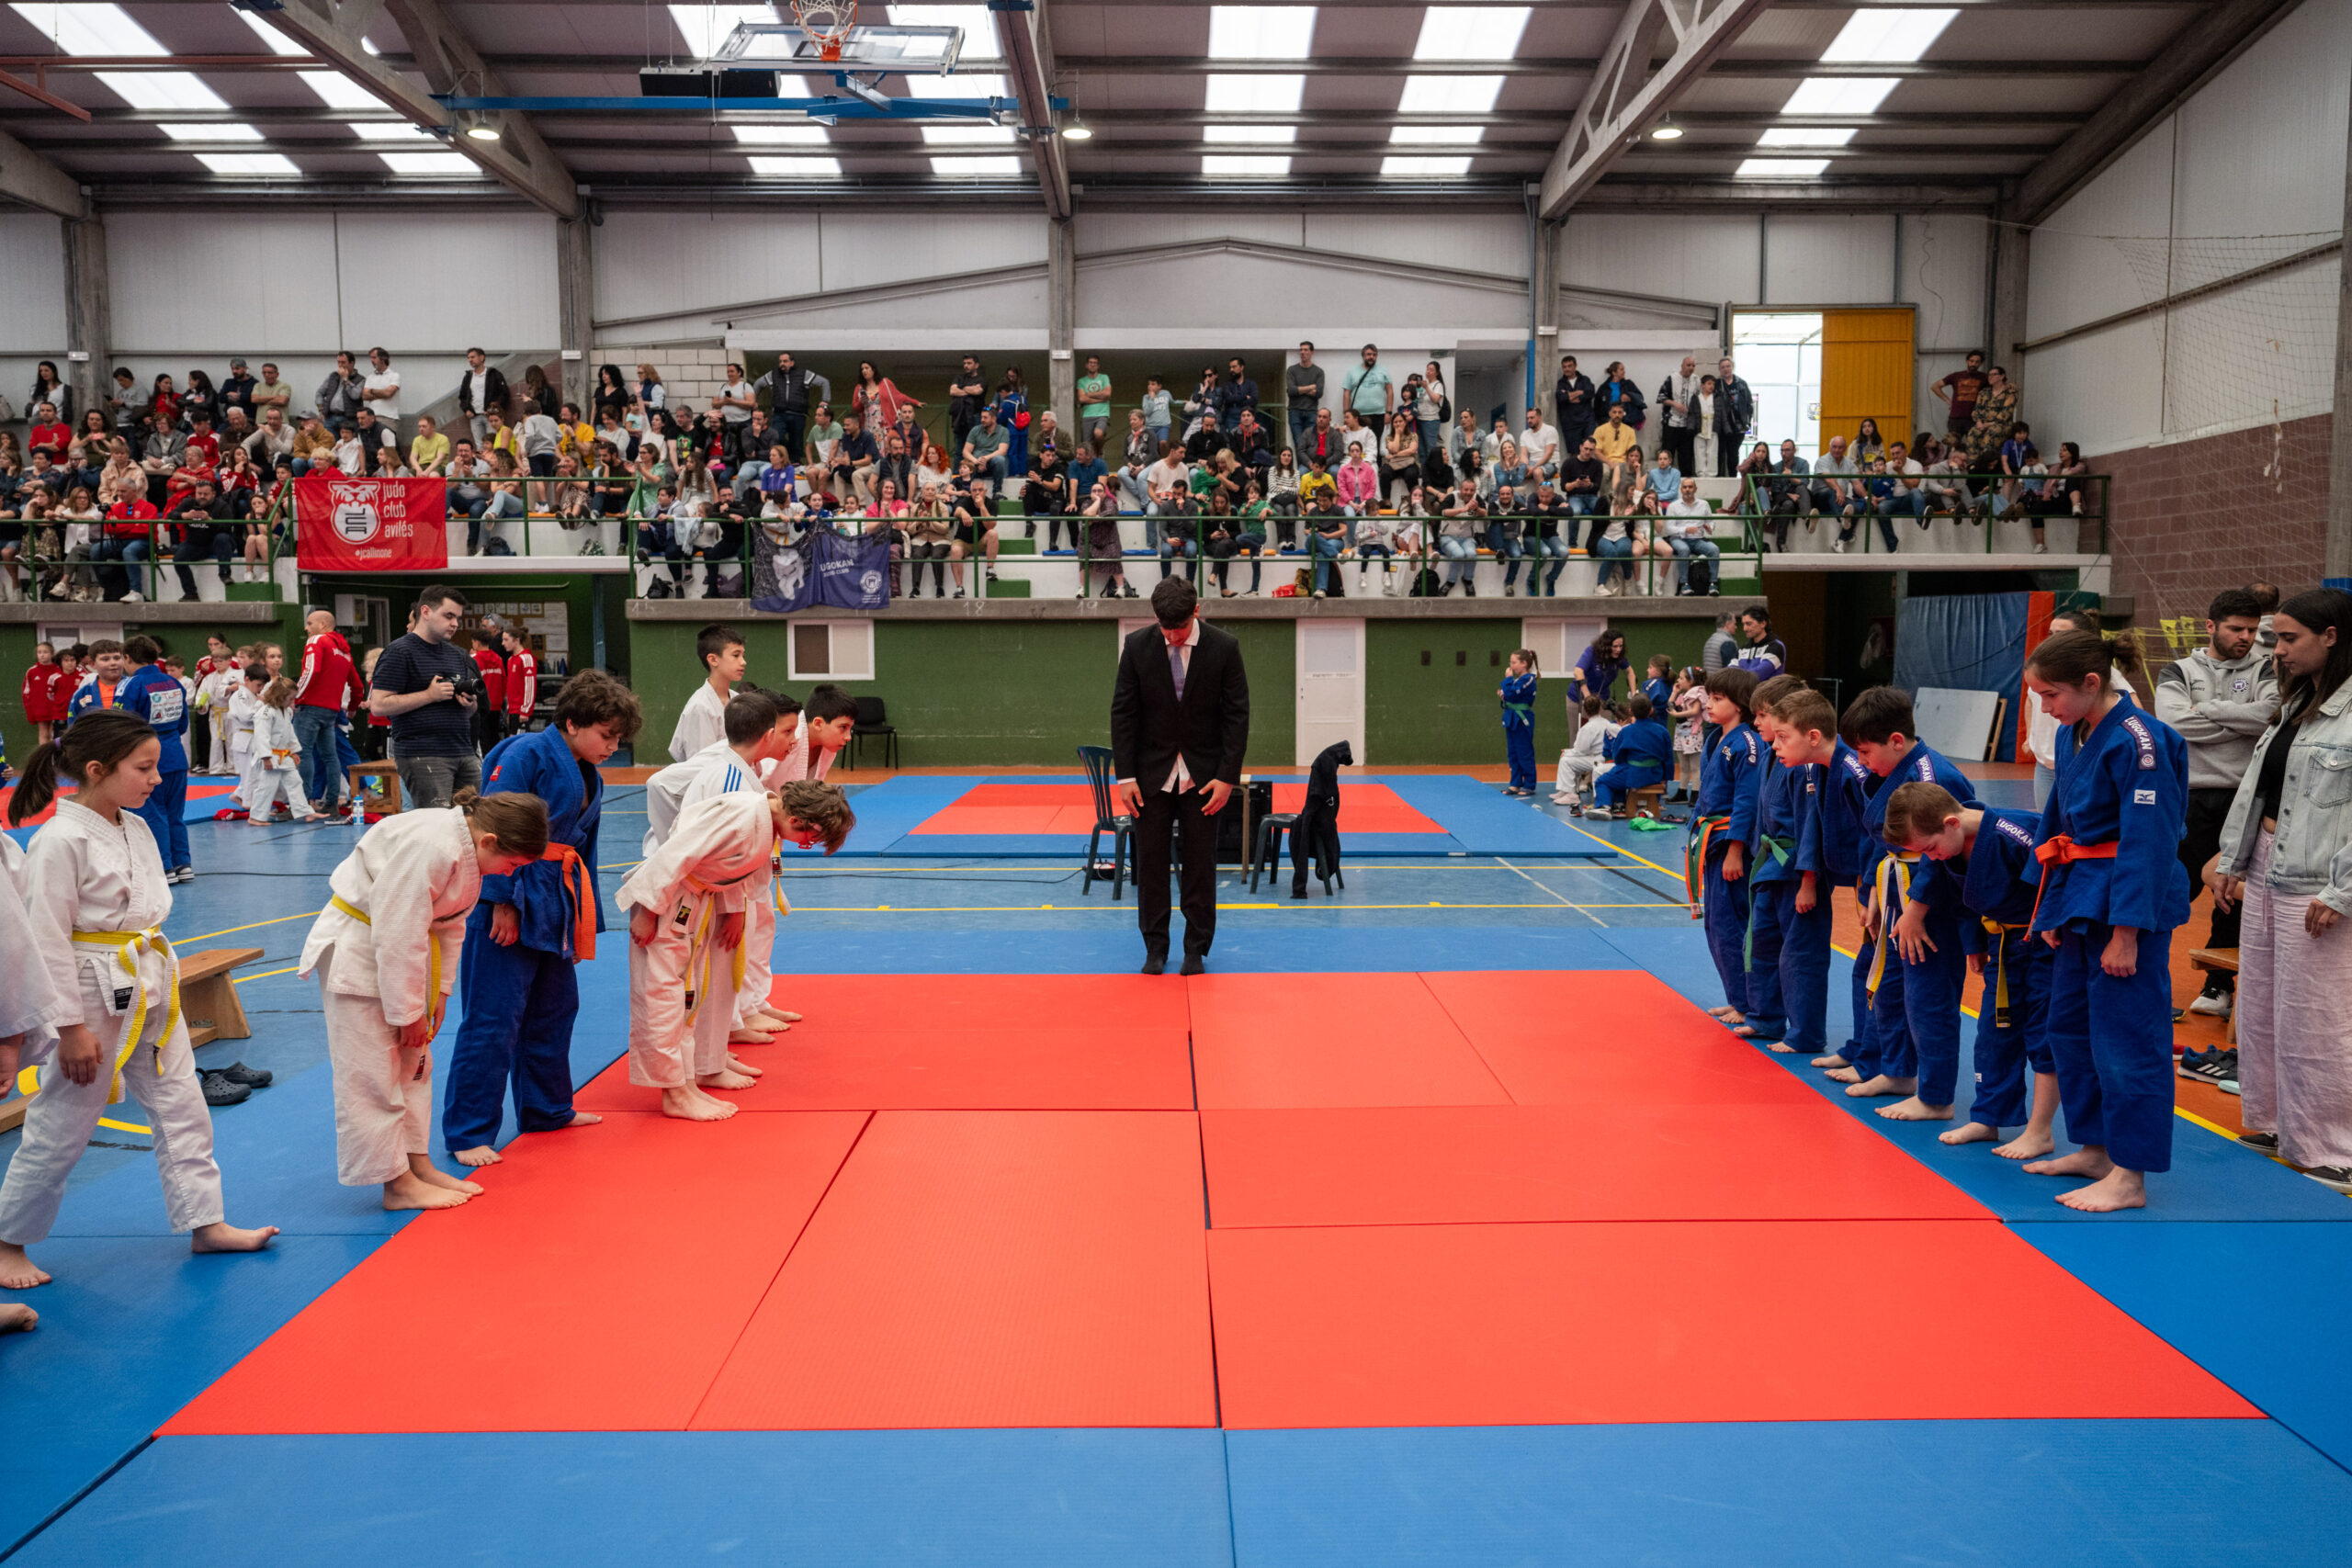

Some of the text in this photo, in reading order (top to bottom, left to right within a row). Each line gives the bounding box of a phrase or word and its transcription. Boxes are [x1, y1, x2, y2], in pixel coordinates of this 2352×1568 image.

[383, 480, 405, 502] judo
[383, 501, 406, 518] club
[384, 521, 413, 538] avilés
[248, 604, 266, 619] 14
[963, 601, 985, 616] 18
[1076, 601, 1098, 616] 19
[1300, 601, 1319, 615] 21
[2124, 716, 2152, 750] LUGOKAN
